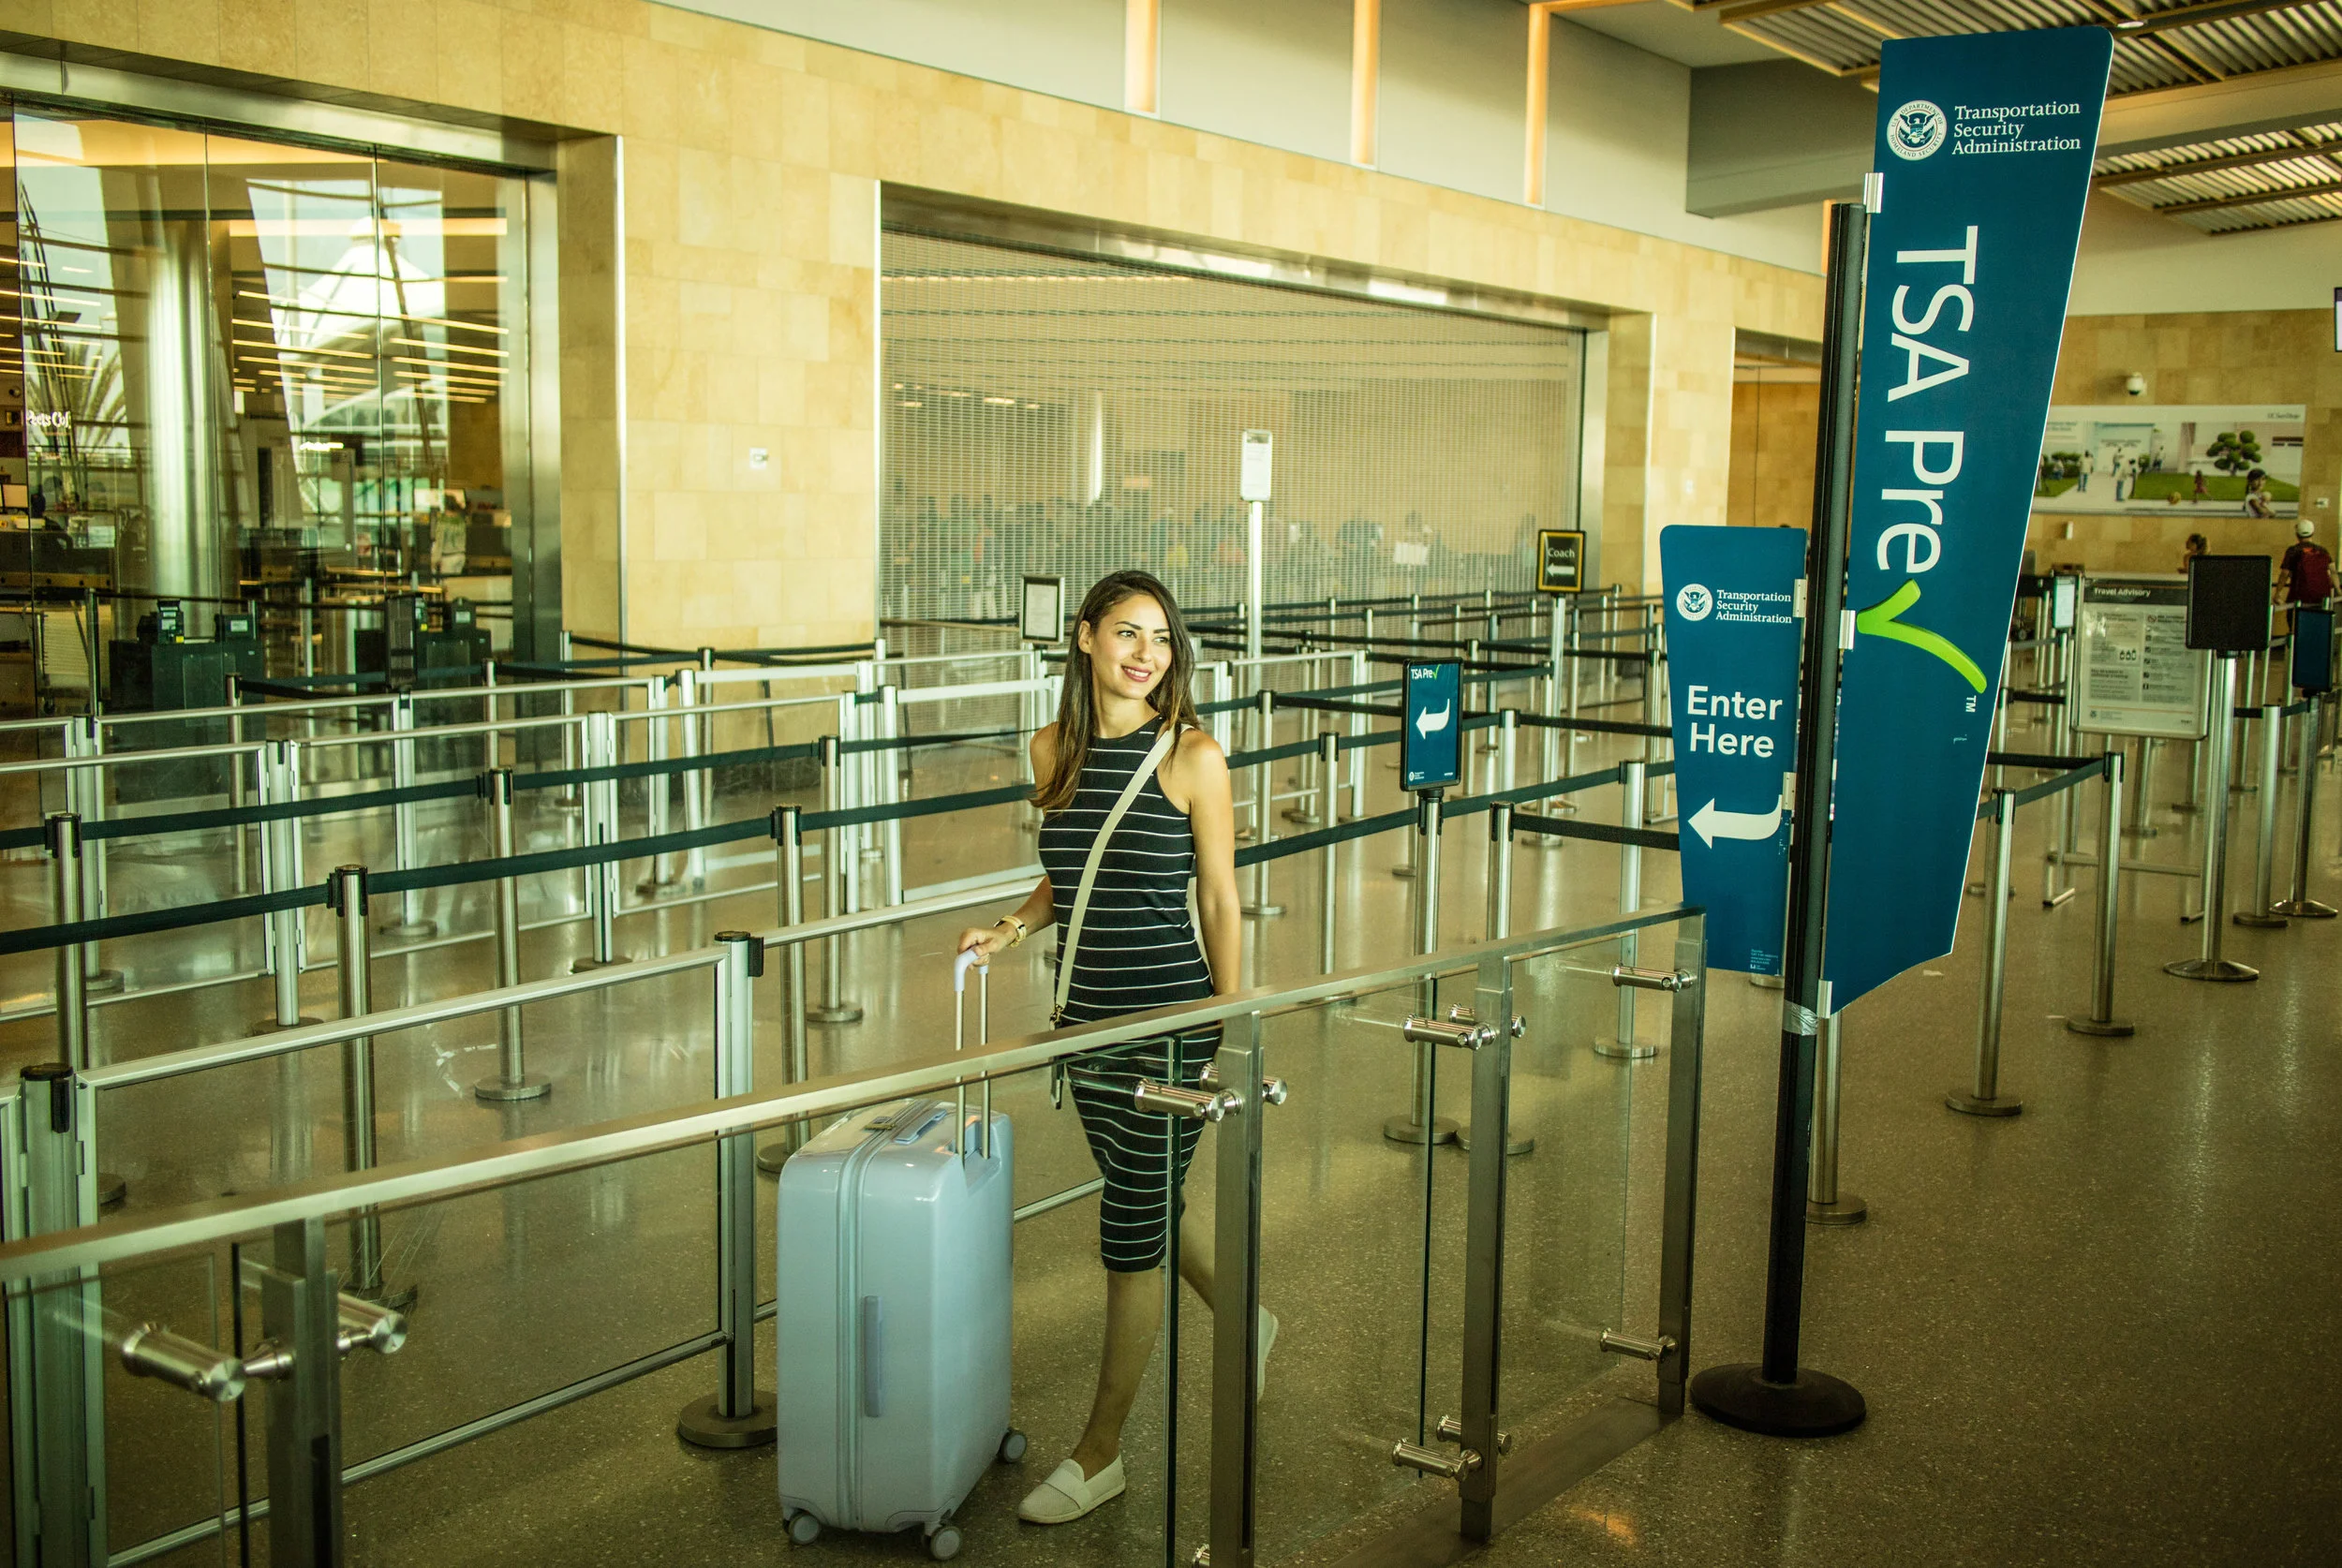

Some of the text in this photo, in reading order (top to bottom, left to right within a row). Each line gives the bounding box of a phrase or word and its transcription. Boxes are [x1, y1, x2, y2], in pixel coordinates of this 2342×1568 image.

[1954, 101, 2082, 123] Transportation
[1953, 122, 2024, 140] Security
[1951, 136, 2082, 155] Administration
[1876, 225, 1979, 573] TSA Pre
[1548, 548, 1576, 558] Coach
[1716, 589, 1792, 602] Transportation
[2094, 586, 2152, 599] Travel Advisory
[1716, 600, 1759, 614] Security
[1715, 611, 1793, 624] Administration
[1411, 668, 1433, 680] TSA Pre
[1687, 685, 1784, 720] Enter
[1965, 695, 1977, 713] TM
[1689, 722, 1774, 758] Here
